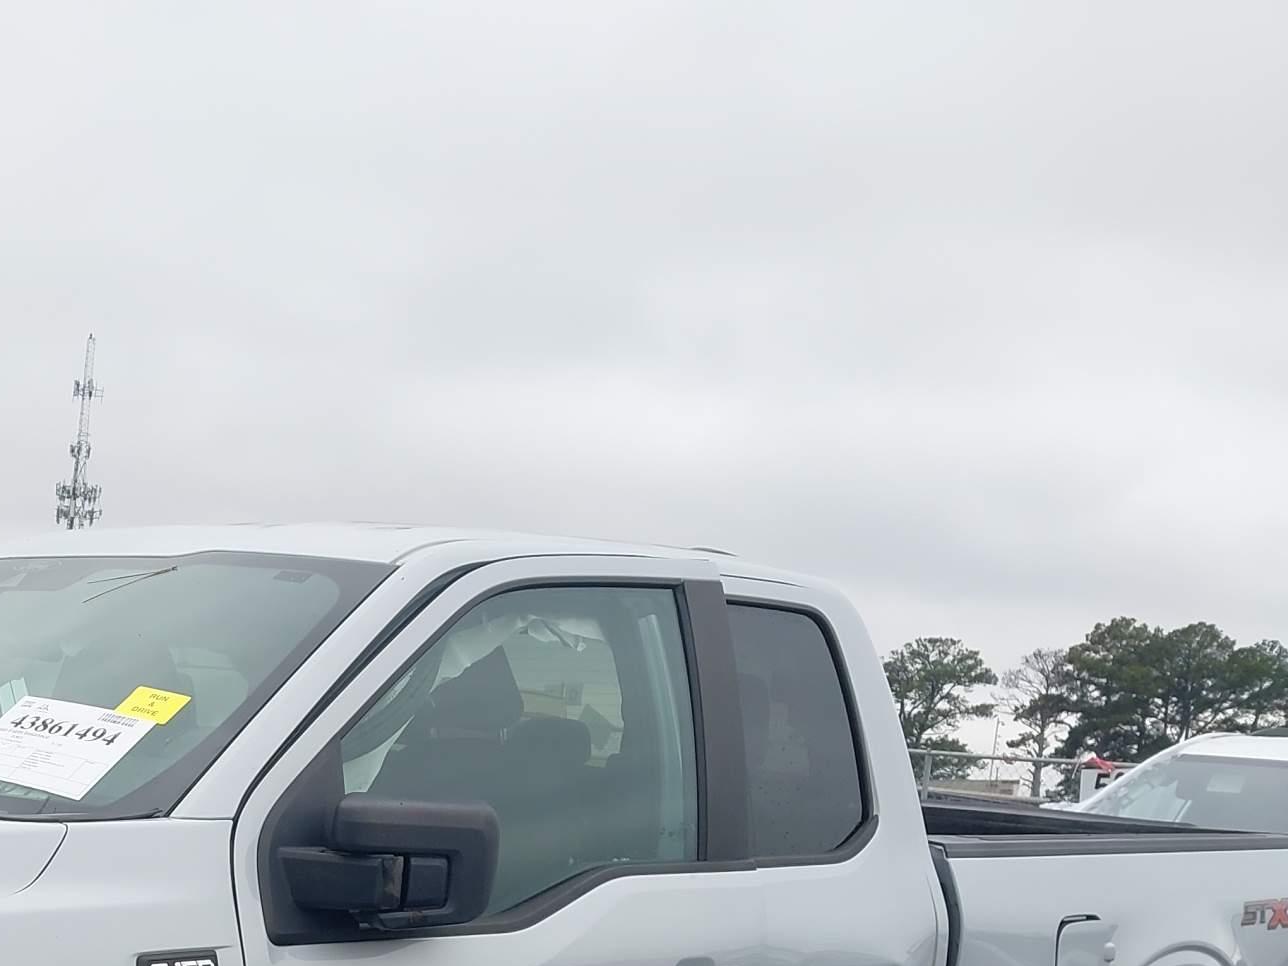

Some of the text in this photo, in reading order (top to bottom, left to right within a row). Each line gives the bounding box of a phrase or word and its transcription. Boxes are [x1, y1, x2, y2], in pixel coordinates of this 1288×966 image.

[149, 693, 171, 703] RUN
[130, 706, 160, 716] DRIVE
[10, 714, 122, 746] 43861494
